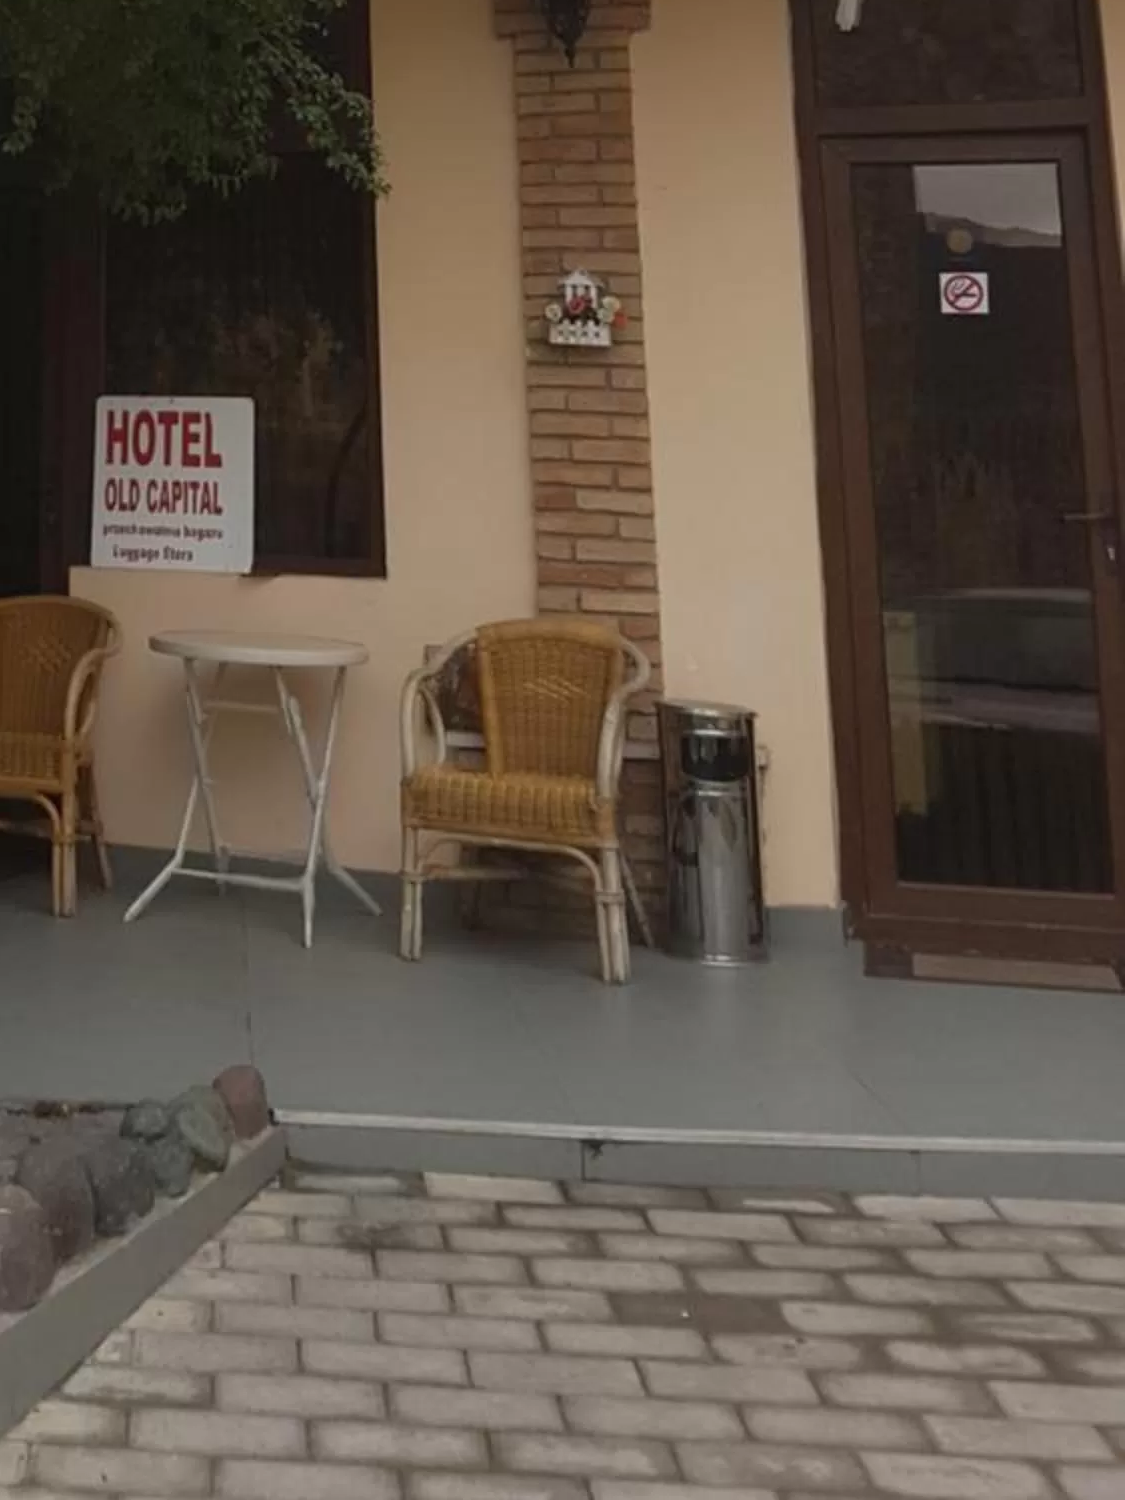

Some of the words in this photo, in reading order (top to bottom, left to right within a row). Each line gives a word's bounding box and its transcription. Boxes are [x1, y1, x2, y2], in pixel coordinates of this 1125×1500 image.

[105, 409, 223, 468] HOTEL
[104, 478, 140, 512] OLD
[146, 479, 223, 515] CAPITAL
